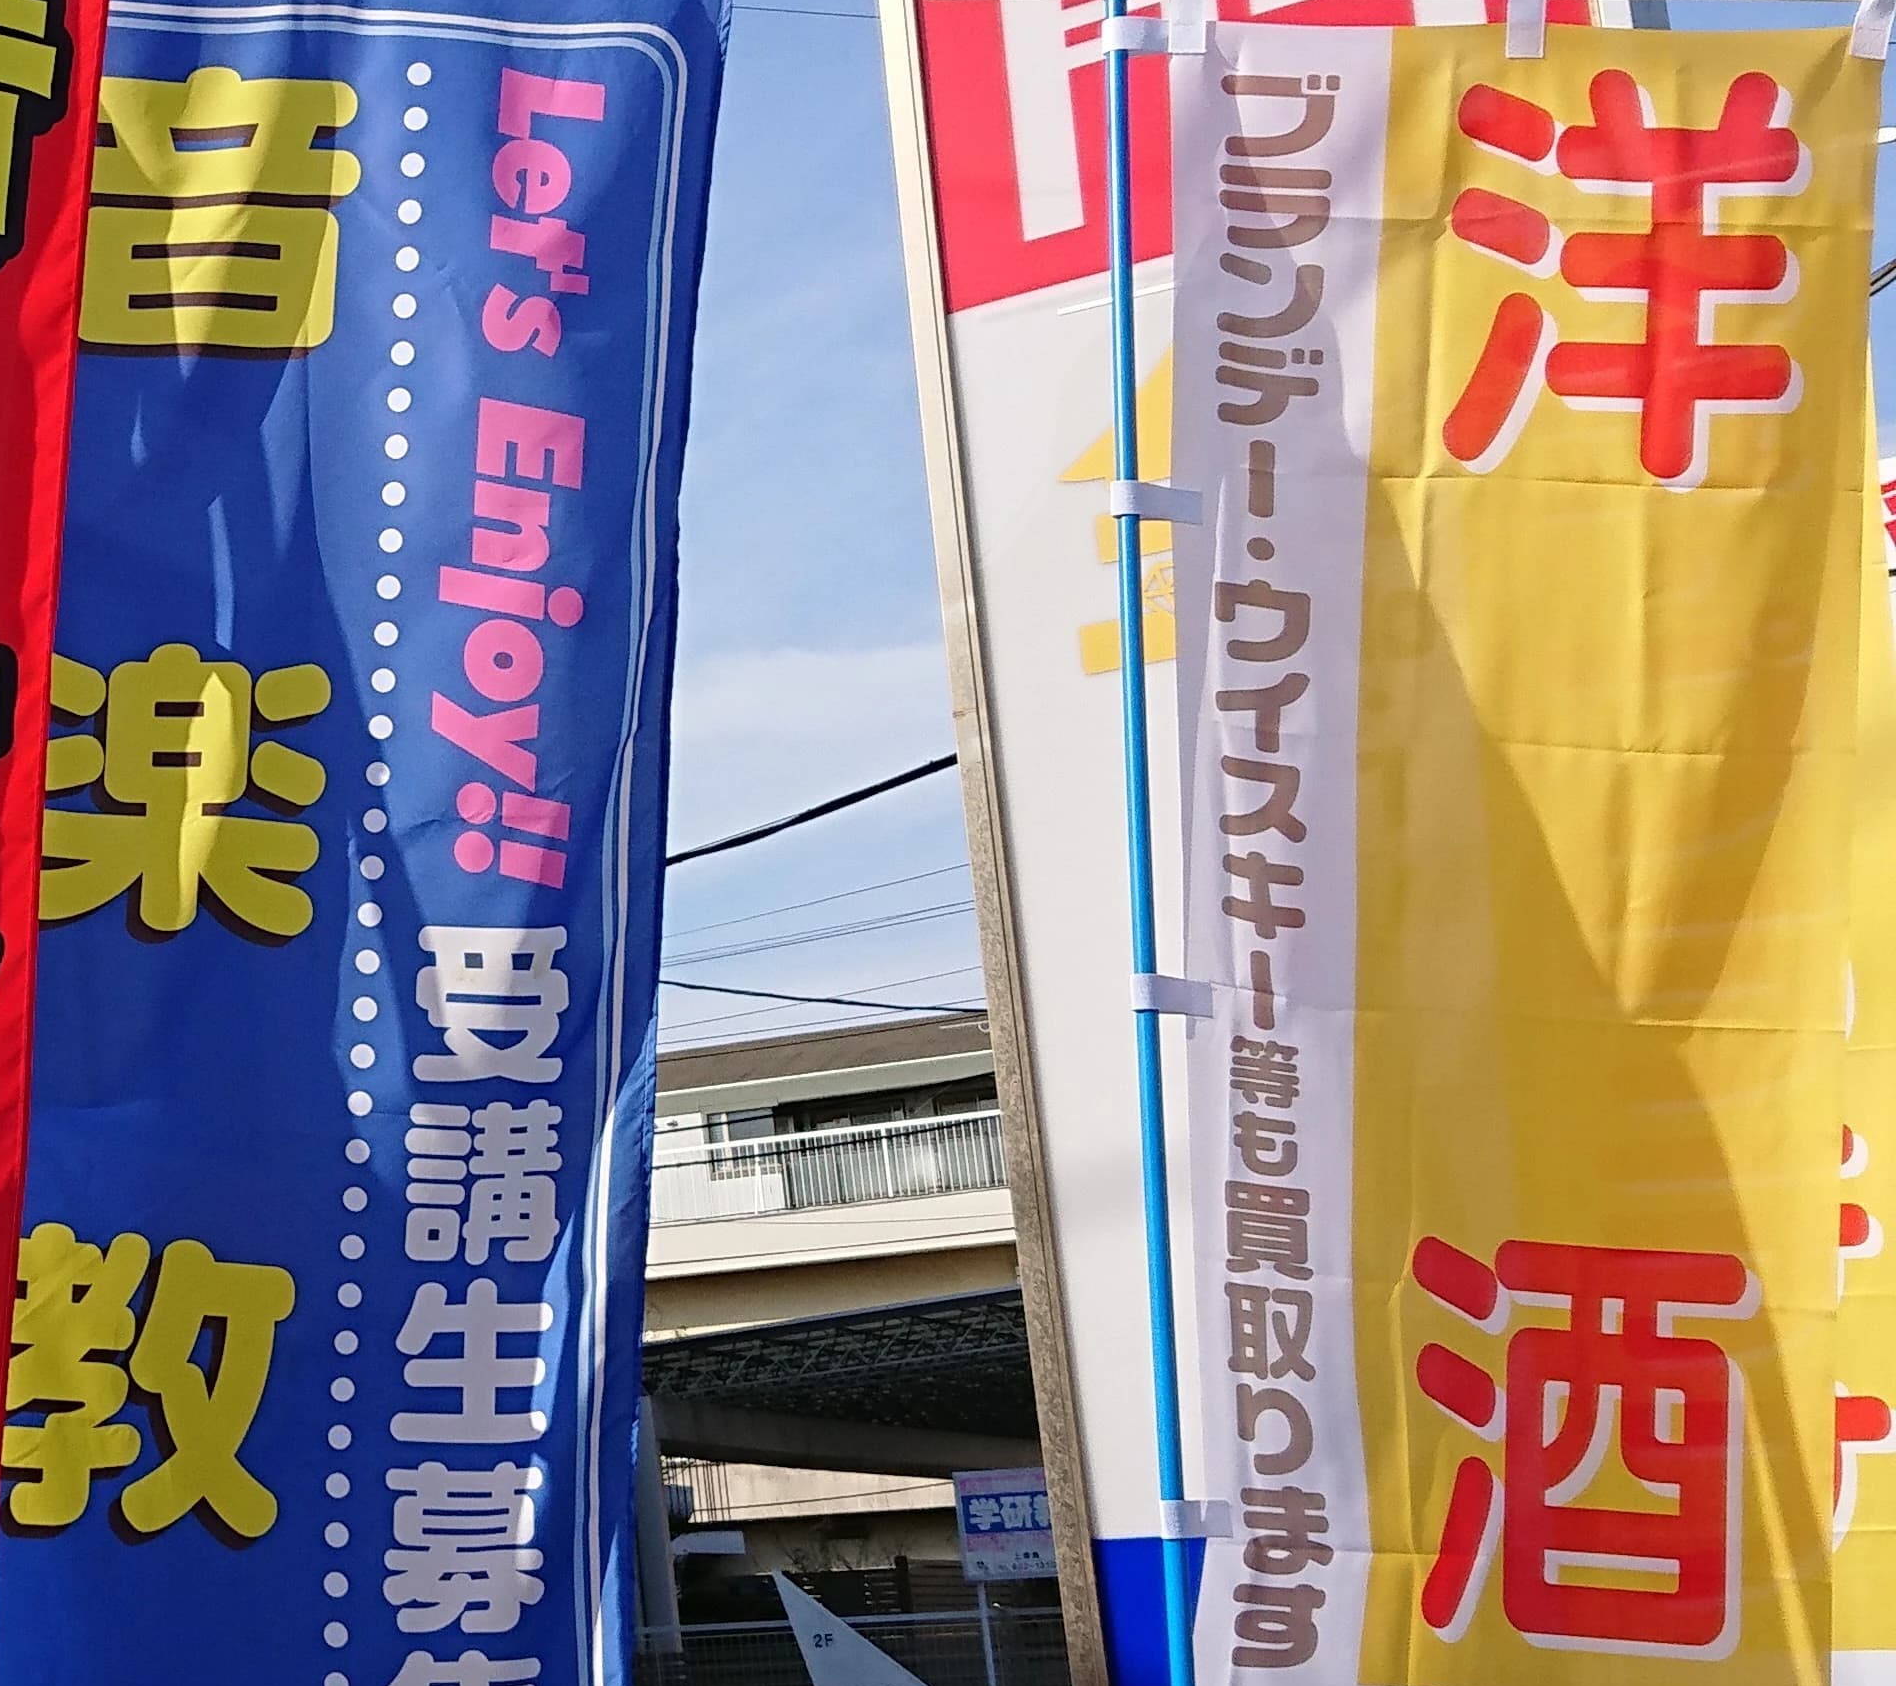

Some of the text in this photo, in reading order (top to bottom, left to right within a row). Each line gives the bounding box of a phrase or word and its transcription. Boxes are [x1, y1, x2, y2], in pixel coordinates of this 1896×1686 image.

[431, 65, 605, 889] Let's Enjoy!!
[1412, 68, 1814, 1662] 洋酒
[813, 1633, 833, 1648] 2F
